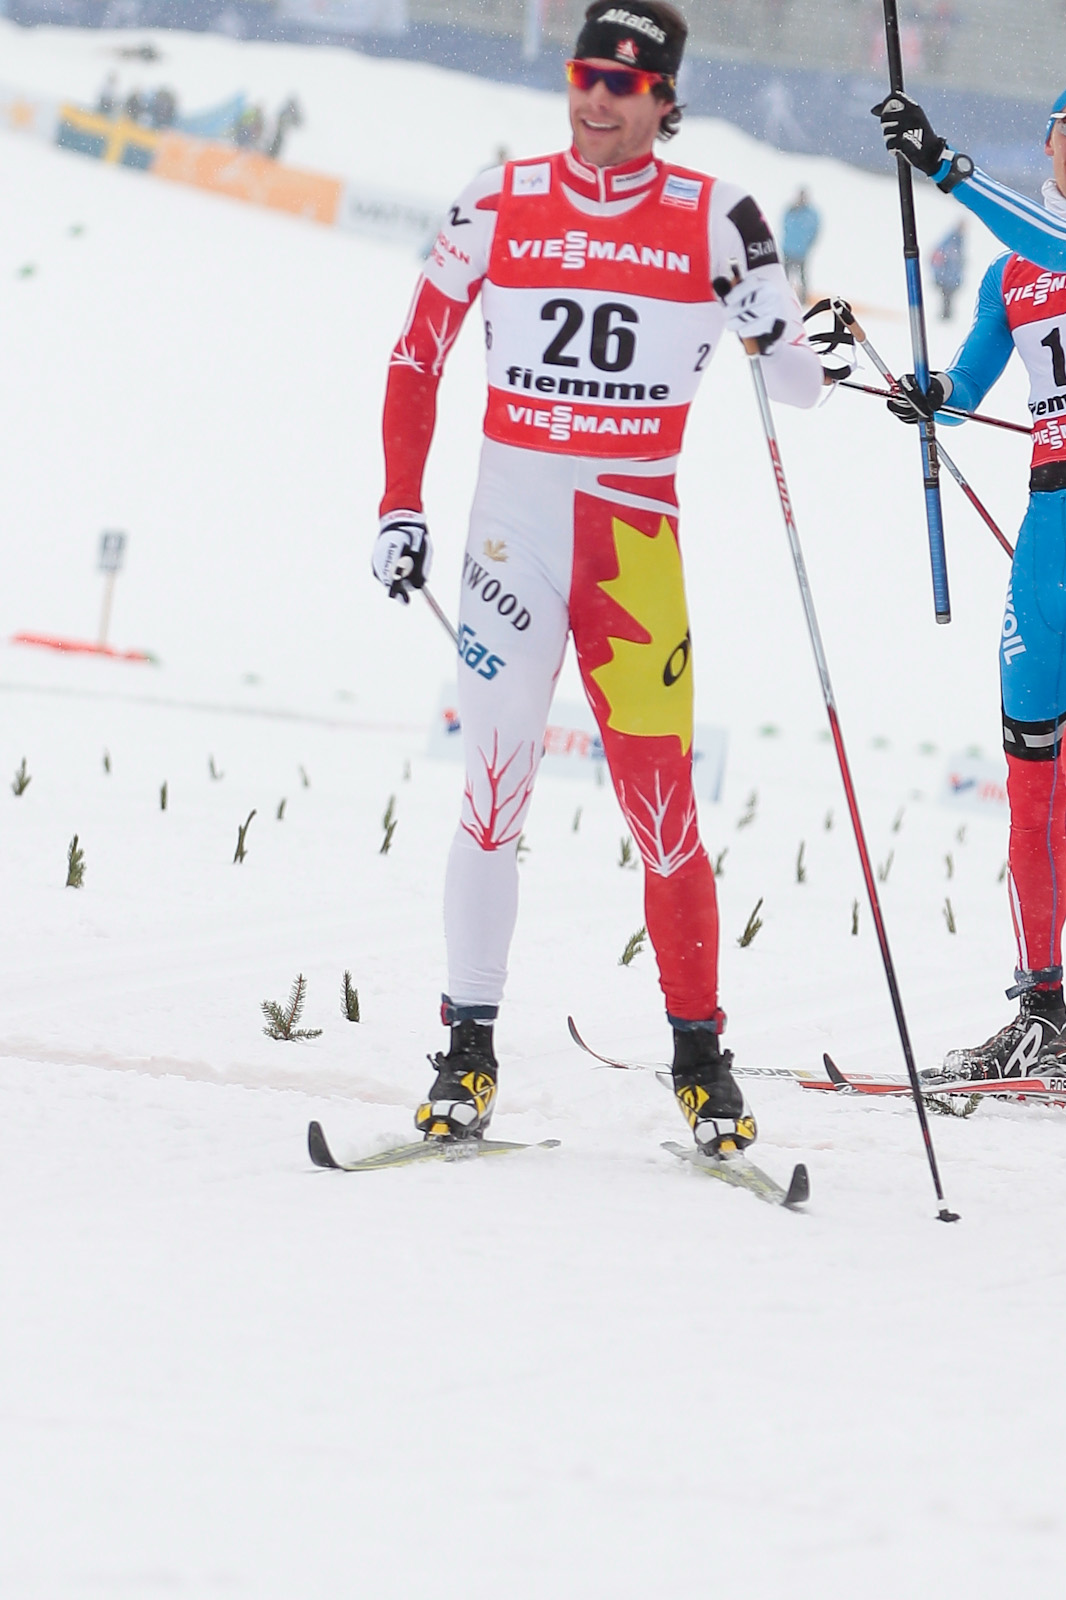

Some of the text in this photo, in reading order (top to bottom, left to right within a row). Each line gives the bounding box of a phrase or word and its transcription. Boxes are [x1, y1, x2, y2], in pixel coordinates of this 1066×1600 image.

[597, 7, 667, 45] AltaGas
[508, 229, 691, 275] VIESSMANN
[540, 297, 640, 373] 26
[506, 365, 670, 401] fiemme
[506, 404, 661, 442] VIESSMANN
